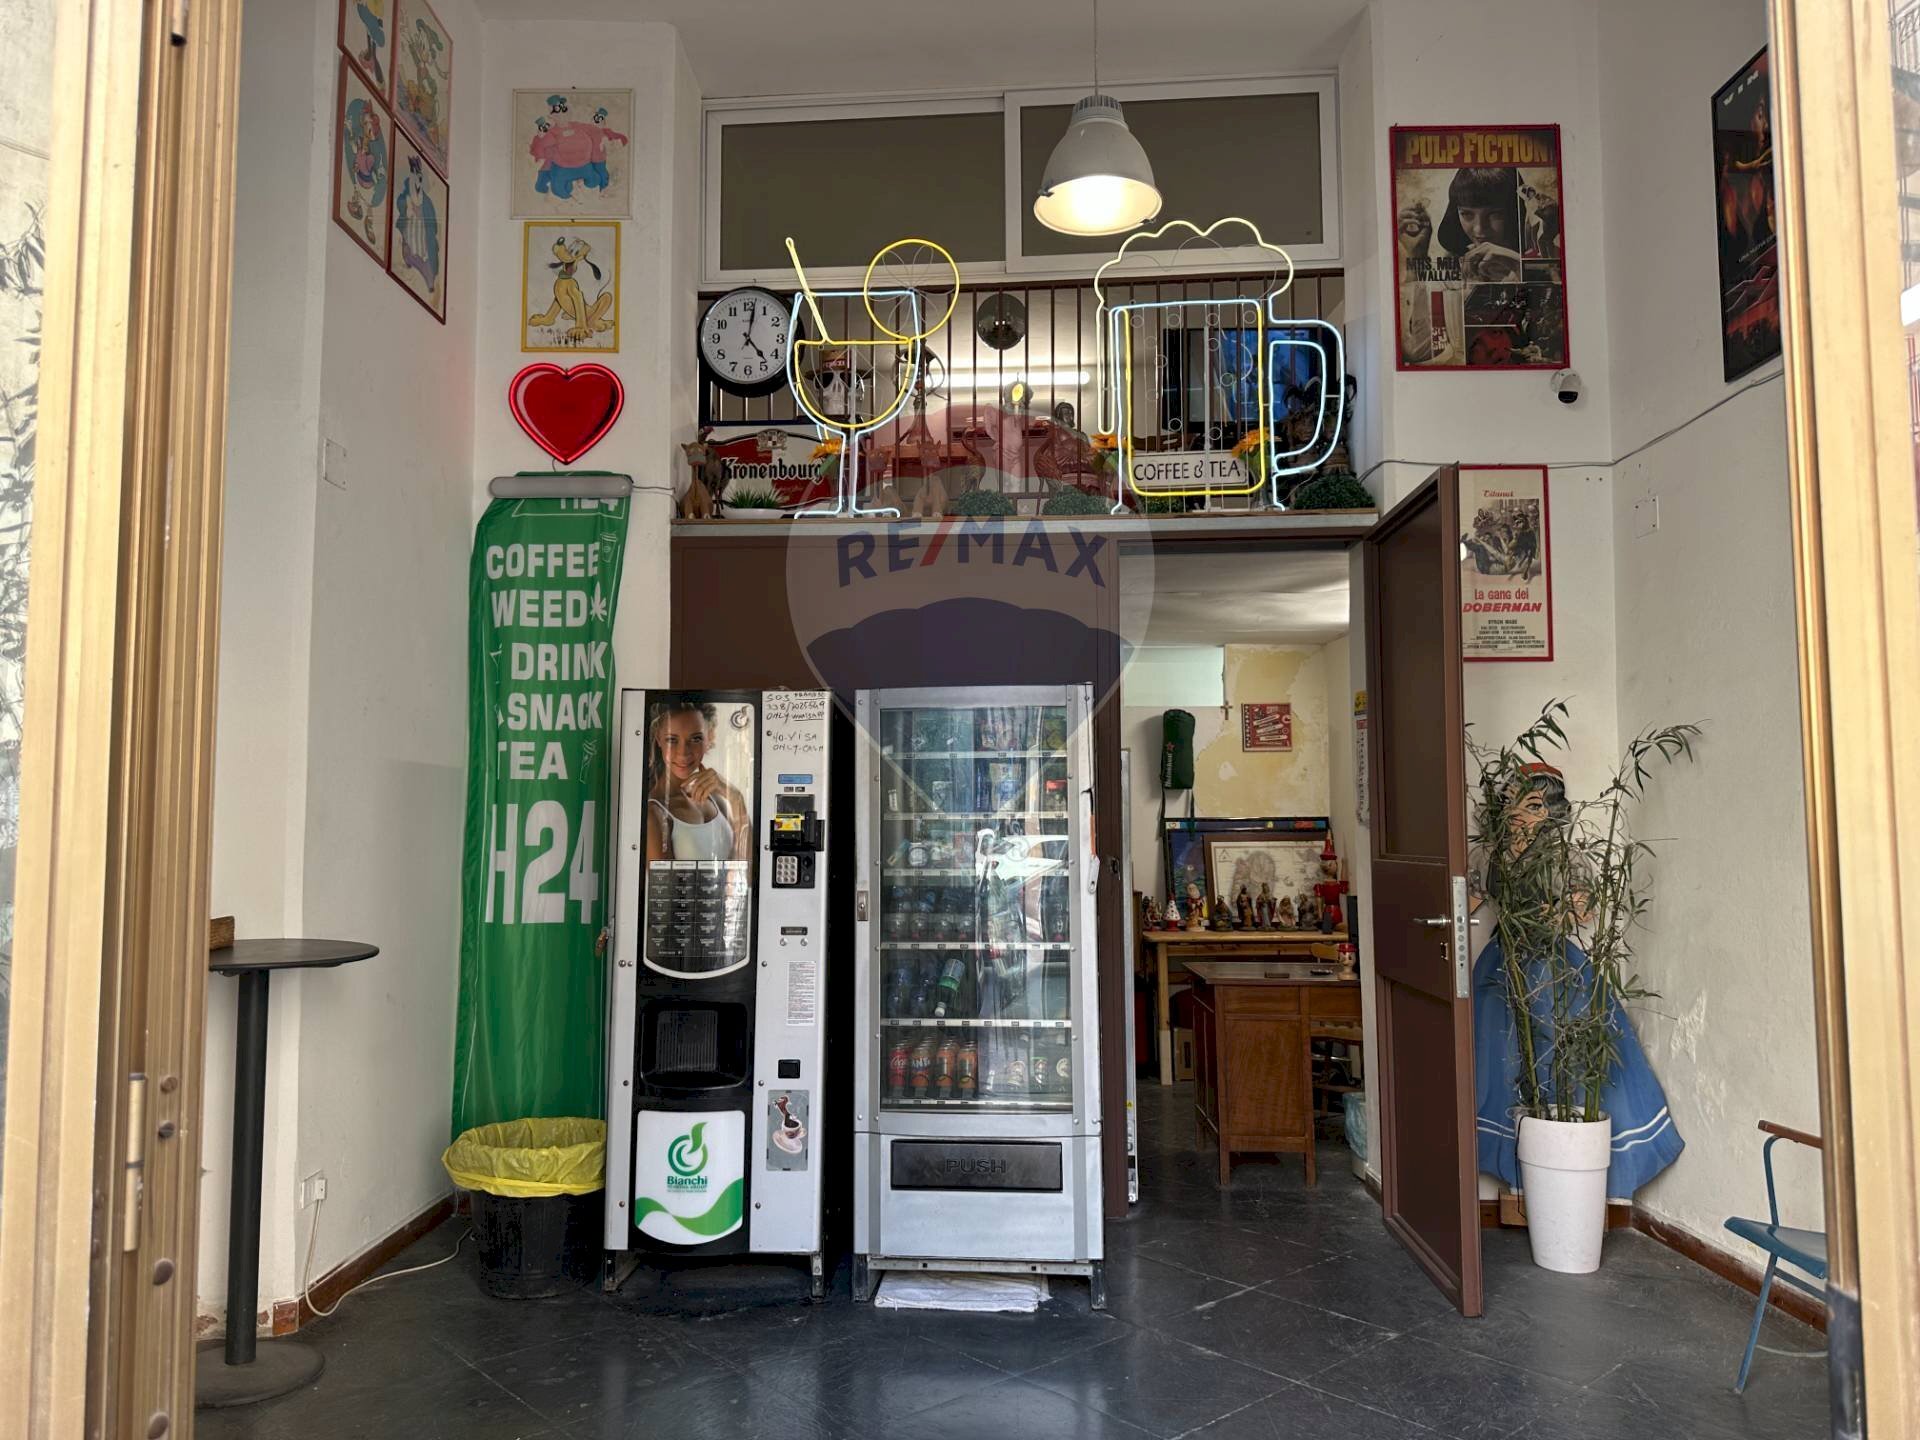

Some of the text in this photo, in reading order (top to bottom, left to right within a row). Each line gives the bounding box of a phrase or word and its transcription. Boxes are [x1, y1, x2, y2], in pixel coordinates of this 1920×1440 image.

[1406, 132, 1548, 164] PULP FICTION
[1417, 270, 1462, 282] WALLACE
[728, 307, 737, 317] 11
[744, 301, 754, 312] 12
[762, 306, 767, 316] 1
[717, 319, 727, 330] 10
[771, 316, 780, 328] 2
[712, 333, 720, 344] 9
[776, 333, 785, 344] 3
[717, 349, 726, 360] 8
[770, 348, 779, 359] 4
[729, 361, 738, 372] 7
[744, 365, 752, 376] 6
[760, 361, 768, 372] 5
[720, 457, 824, 485] Kronenbourg
[1133, 459, 1240, 481] COFFEE & TEA
[486, 542, 600, 580] COFFEE
[491, 589, 588, 628] WEED
[1462, 602, 1542, 613] DOBERMAN
[511, 641, 608, 680] DRINK
[507, 691, 603, 731] SNACK
[485, 800, 599, 925] H24
[946, 1158, 1007, 1174] PUSH
[667, 1175, 708, 1185] Bianchi
